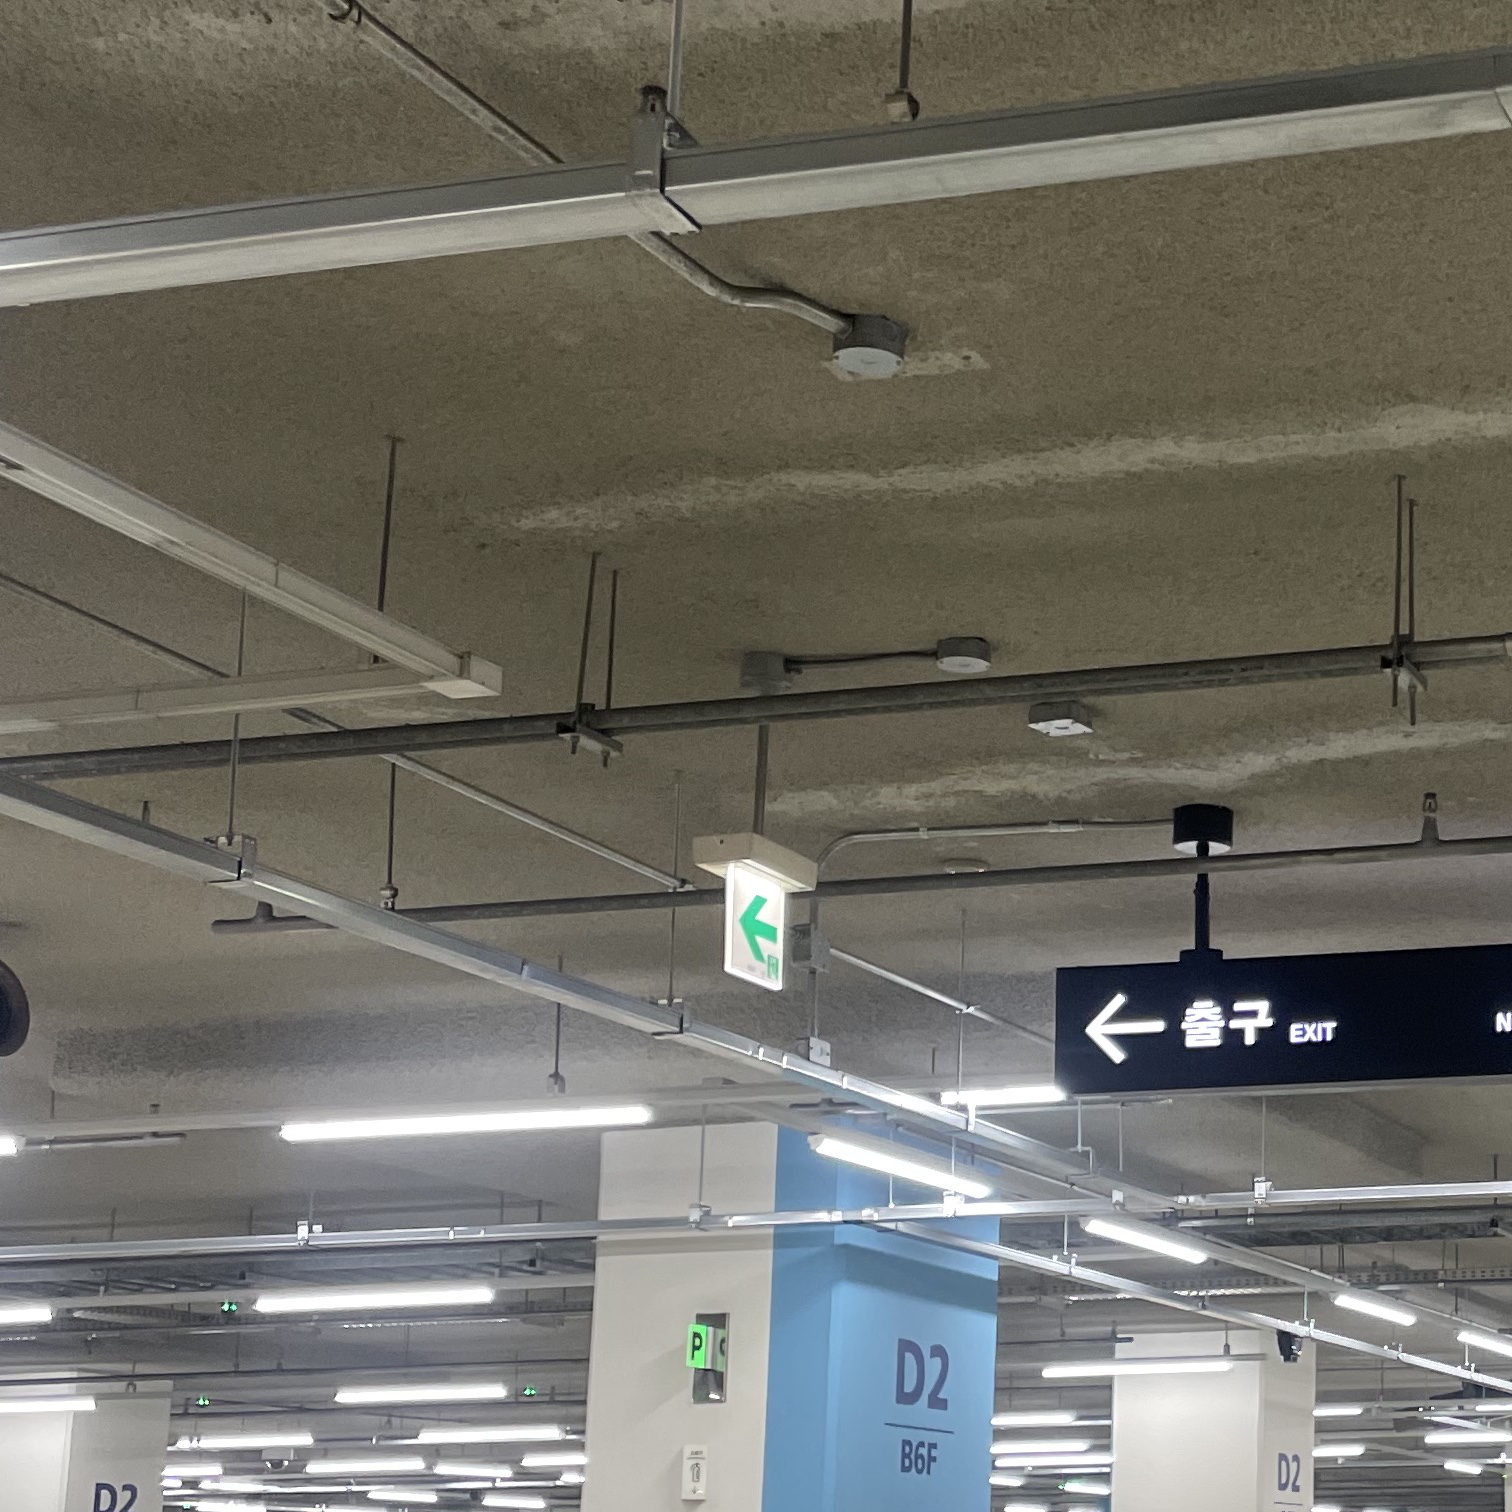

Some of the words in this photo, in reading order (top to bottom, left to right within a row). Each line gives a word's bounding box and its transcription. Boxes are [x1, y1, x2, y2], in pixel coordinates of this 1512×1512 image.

[1180, 999, 1274, 1048] 출구
[1289, 1020, 1337, 1043] EXIT
[691, 1331, 703, 1361] P
[895, 1338, 950, 1411] D2
[900, 1439, 938, 1475] B6F
[1277, 1452, 1301, 1493] D2
